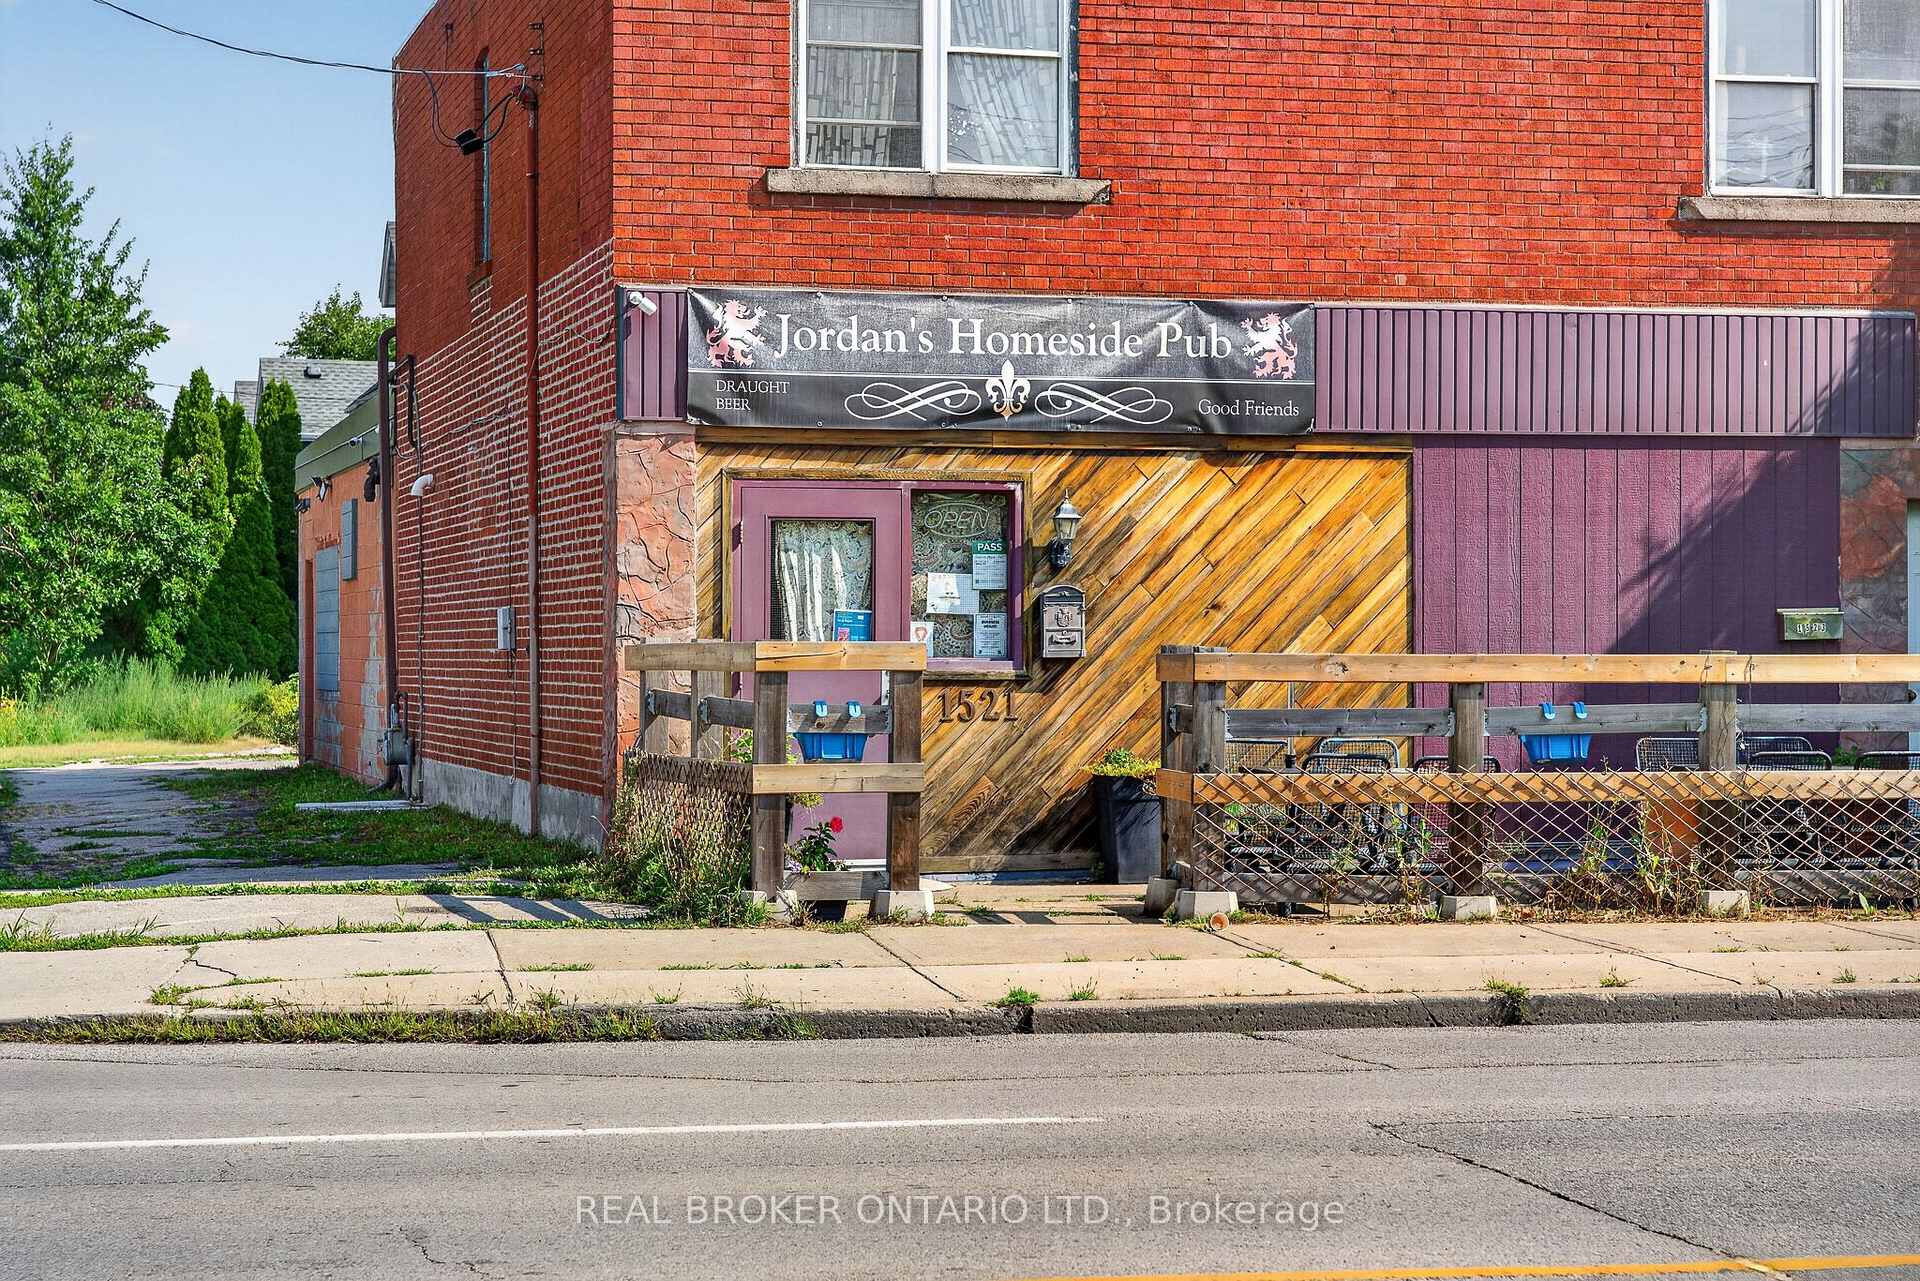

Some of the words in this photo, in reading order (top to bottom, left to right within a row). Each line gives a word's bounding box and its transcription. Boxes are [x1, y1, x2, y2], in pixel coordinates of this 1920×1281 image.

[774, 313, 934, 358] Jordan's
[947, 317, 1143, 358] Homeside
[1156, 321, 1233, 359] Pub
[715, 379, 790, 394] DRAUGHT
[715, 397, 751, 411] BEER
[1198, 398, 1240, 415] Good
[1244, 399, 1299, 416] Friends
[924, 510, 990, 530] OPEN
[977, 543, 1002, 552] PASS
[938, 687, 1019, 724] 1521
